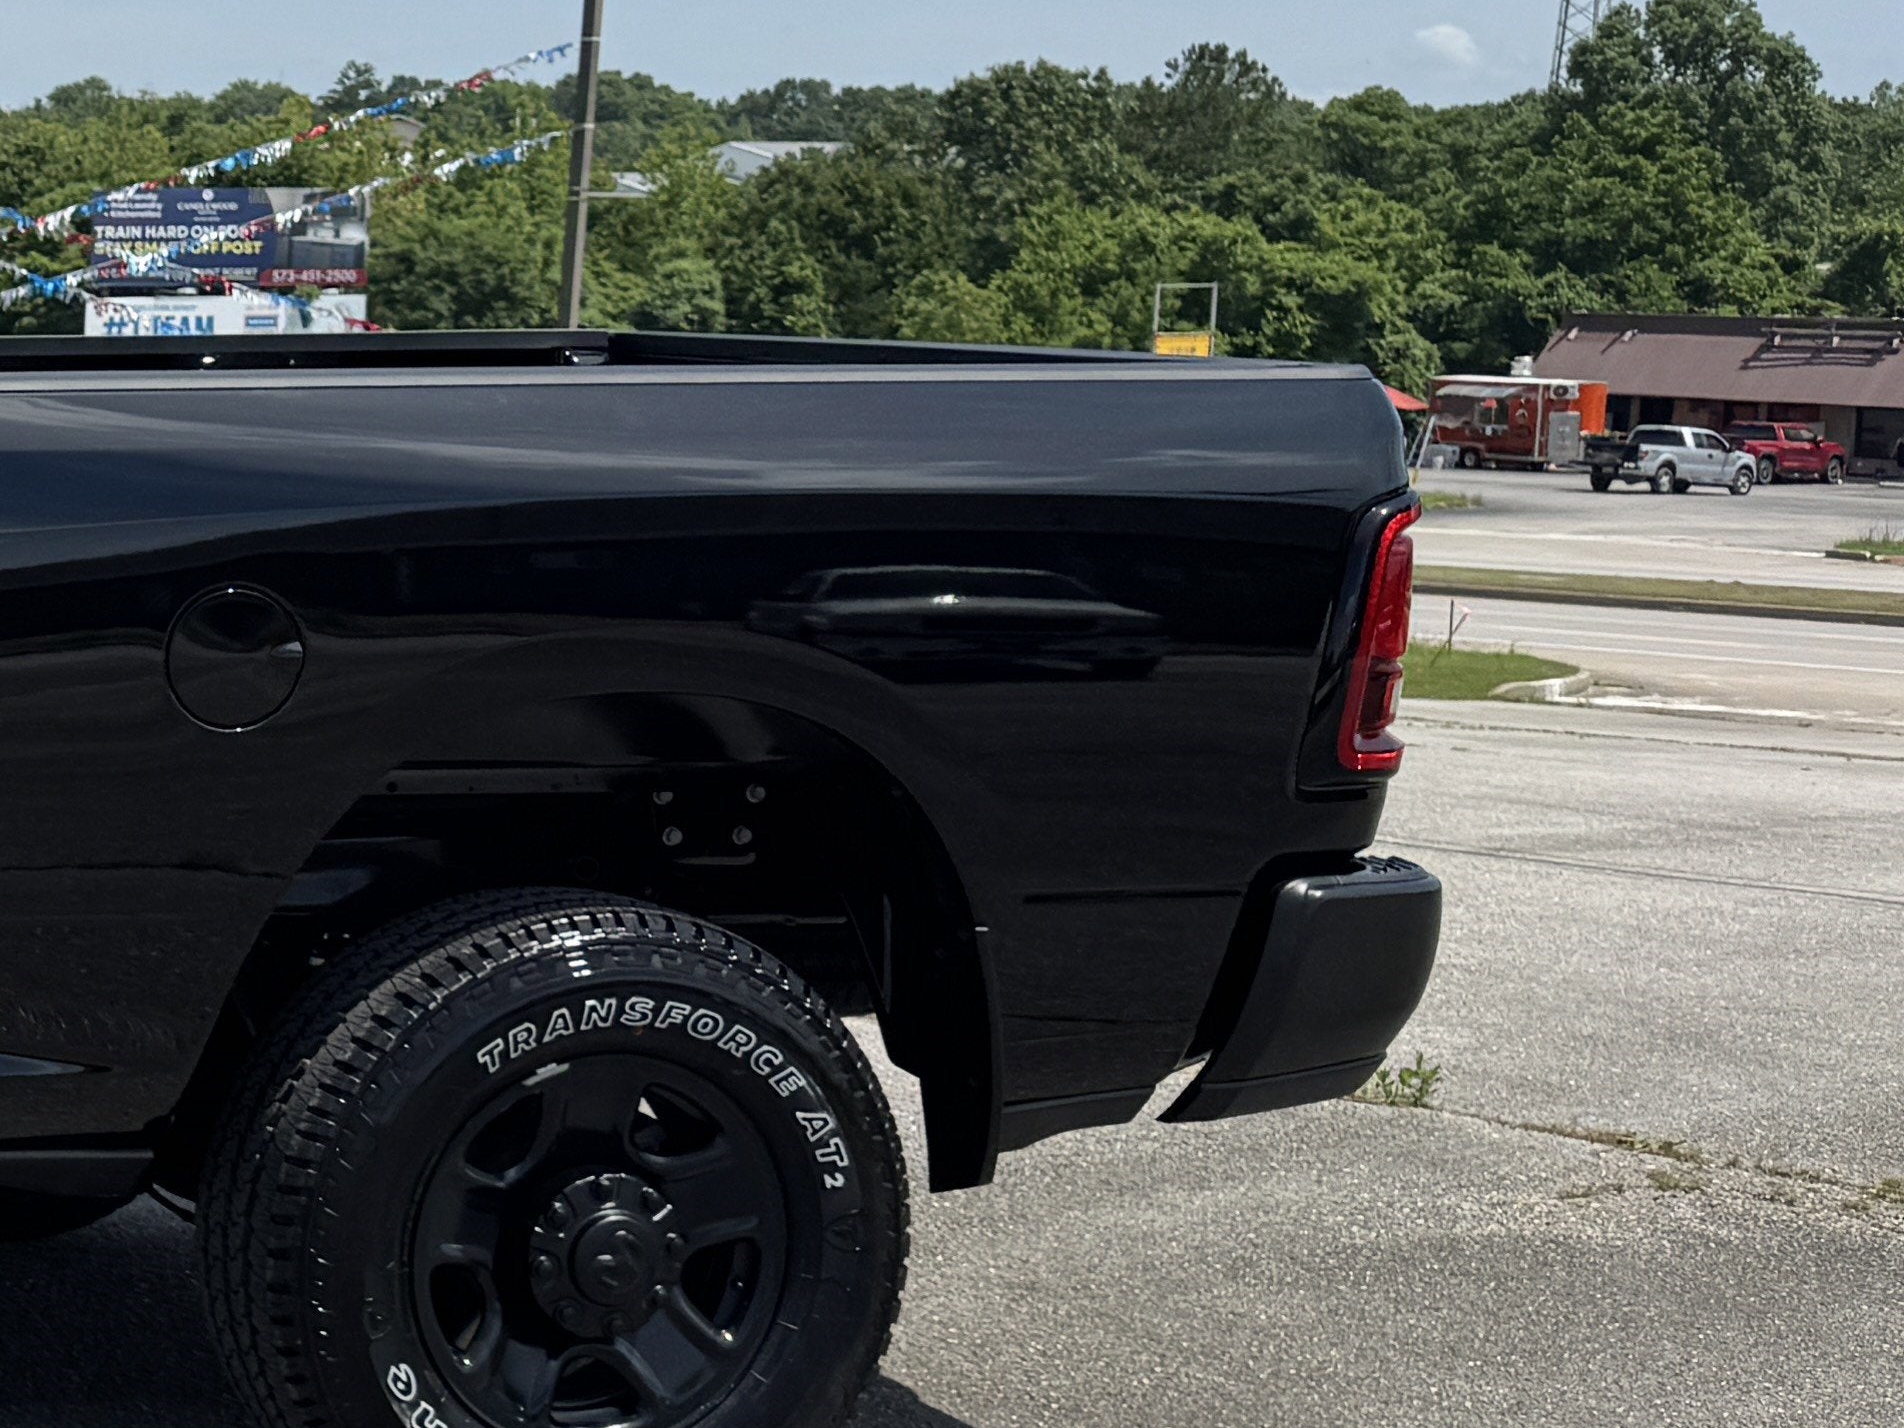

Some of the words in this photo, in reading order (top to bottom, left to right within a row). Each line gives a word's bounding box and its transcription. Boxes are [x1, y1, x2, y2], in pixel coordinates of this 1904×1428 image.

[94, 225, 142, 240] TRAIN
[145, 225, 189, 240] HARD
[222, 241, 264, 255] POST
[477, 996, 806, 1099] TRANSFORCE
